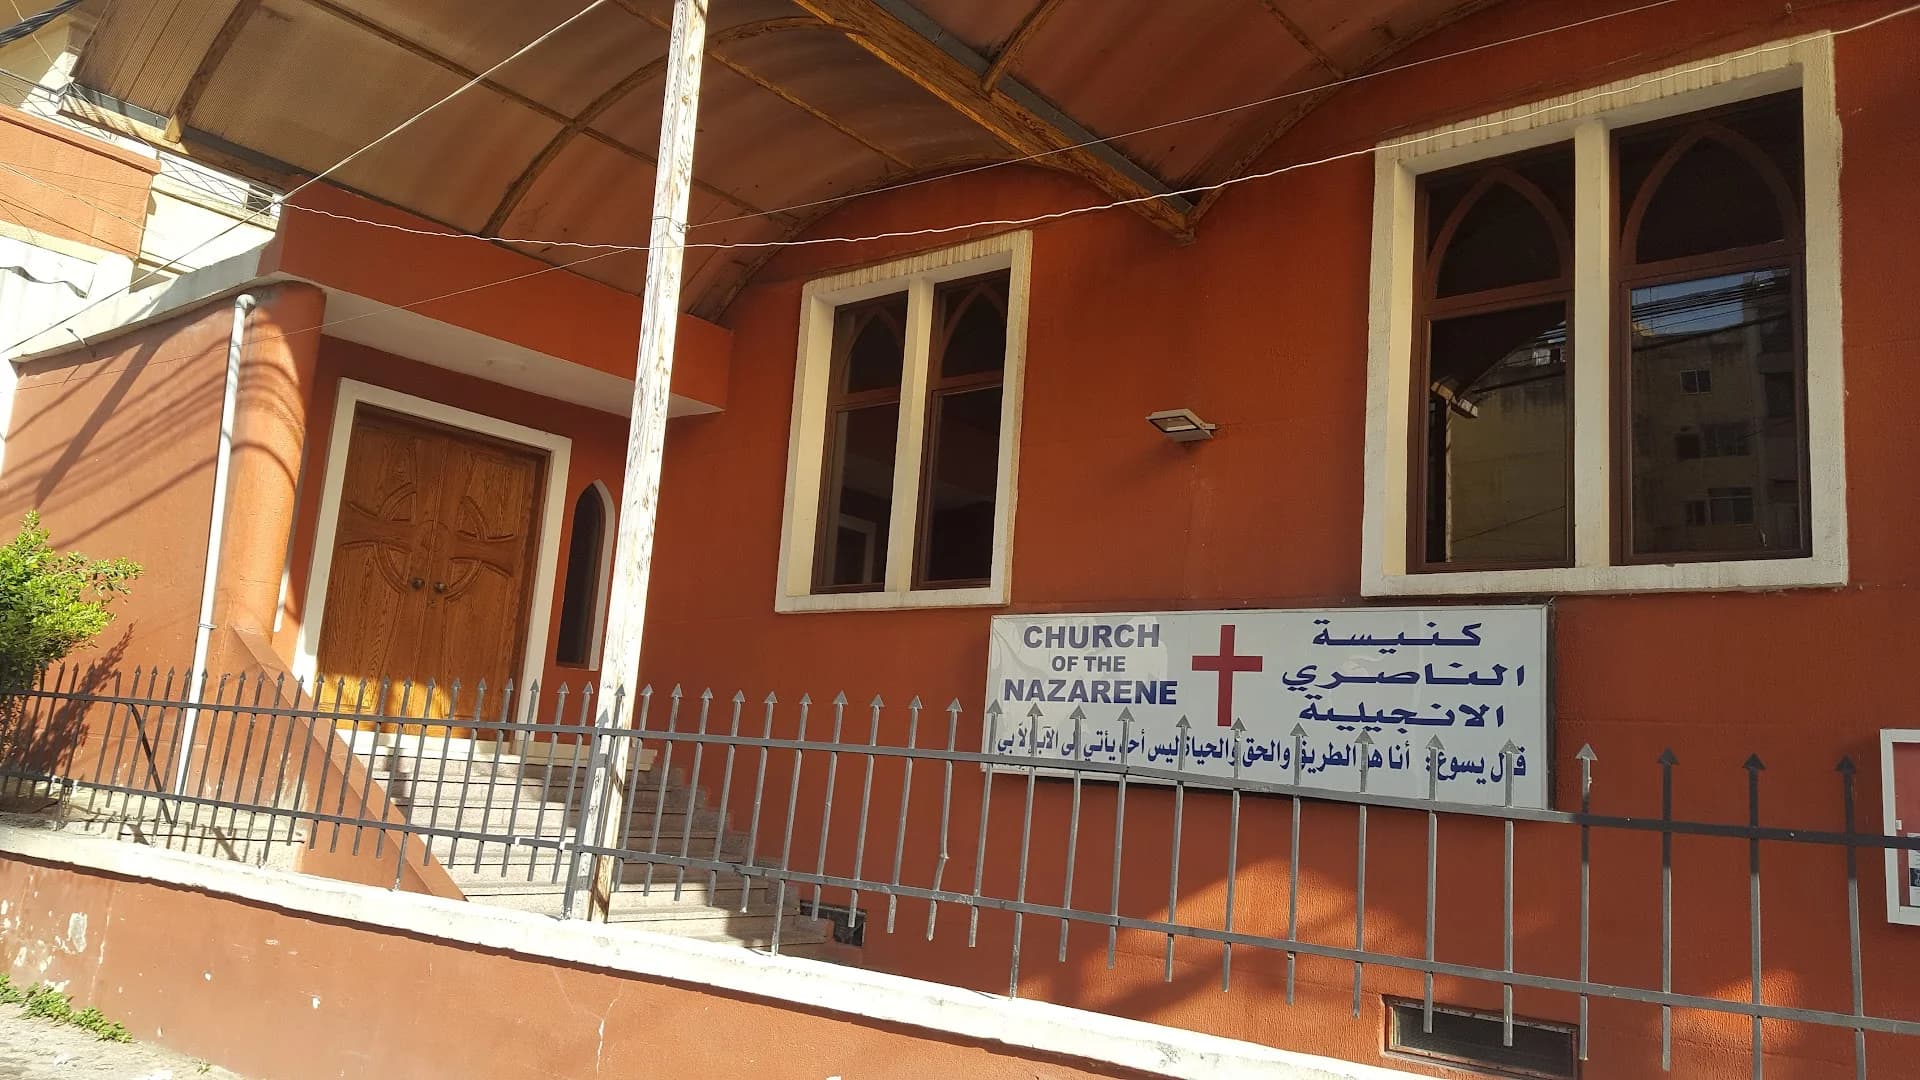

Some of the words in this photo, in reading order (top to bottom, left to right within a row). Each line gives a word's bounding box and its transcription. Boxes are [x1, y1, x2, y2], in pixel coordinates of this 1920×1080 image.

[1024, 624, 1160, 649] CHURCH
[1312, 618, 1482, 655] كنيسة
[1051, 655, 1079, 672] OF
[1083, 655, 1126, 673] THE
[1282, 662, 1525, 692] الناصري
[1003, 679, 1178, 705] NAZARENE
[1299, 693, 1505, 734] الانجيلية
[998, 732, 1014, 756] بي
[1083, 730, 1115, 761] يأتي
[1119, 728, 1144, 754] أح
[1148, 735, 1179, 763] ليس
[1242, 738, 1290, 770] والحق
[1388, 740, 1410, 770] أنا
[1360, 748, 1383, 773] ه
[1490, 746, 1526, 783] قل
